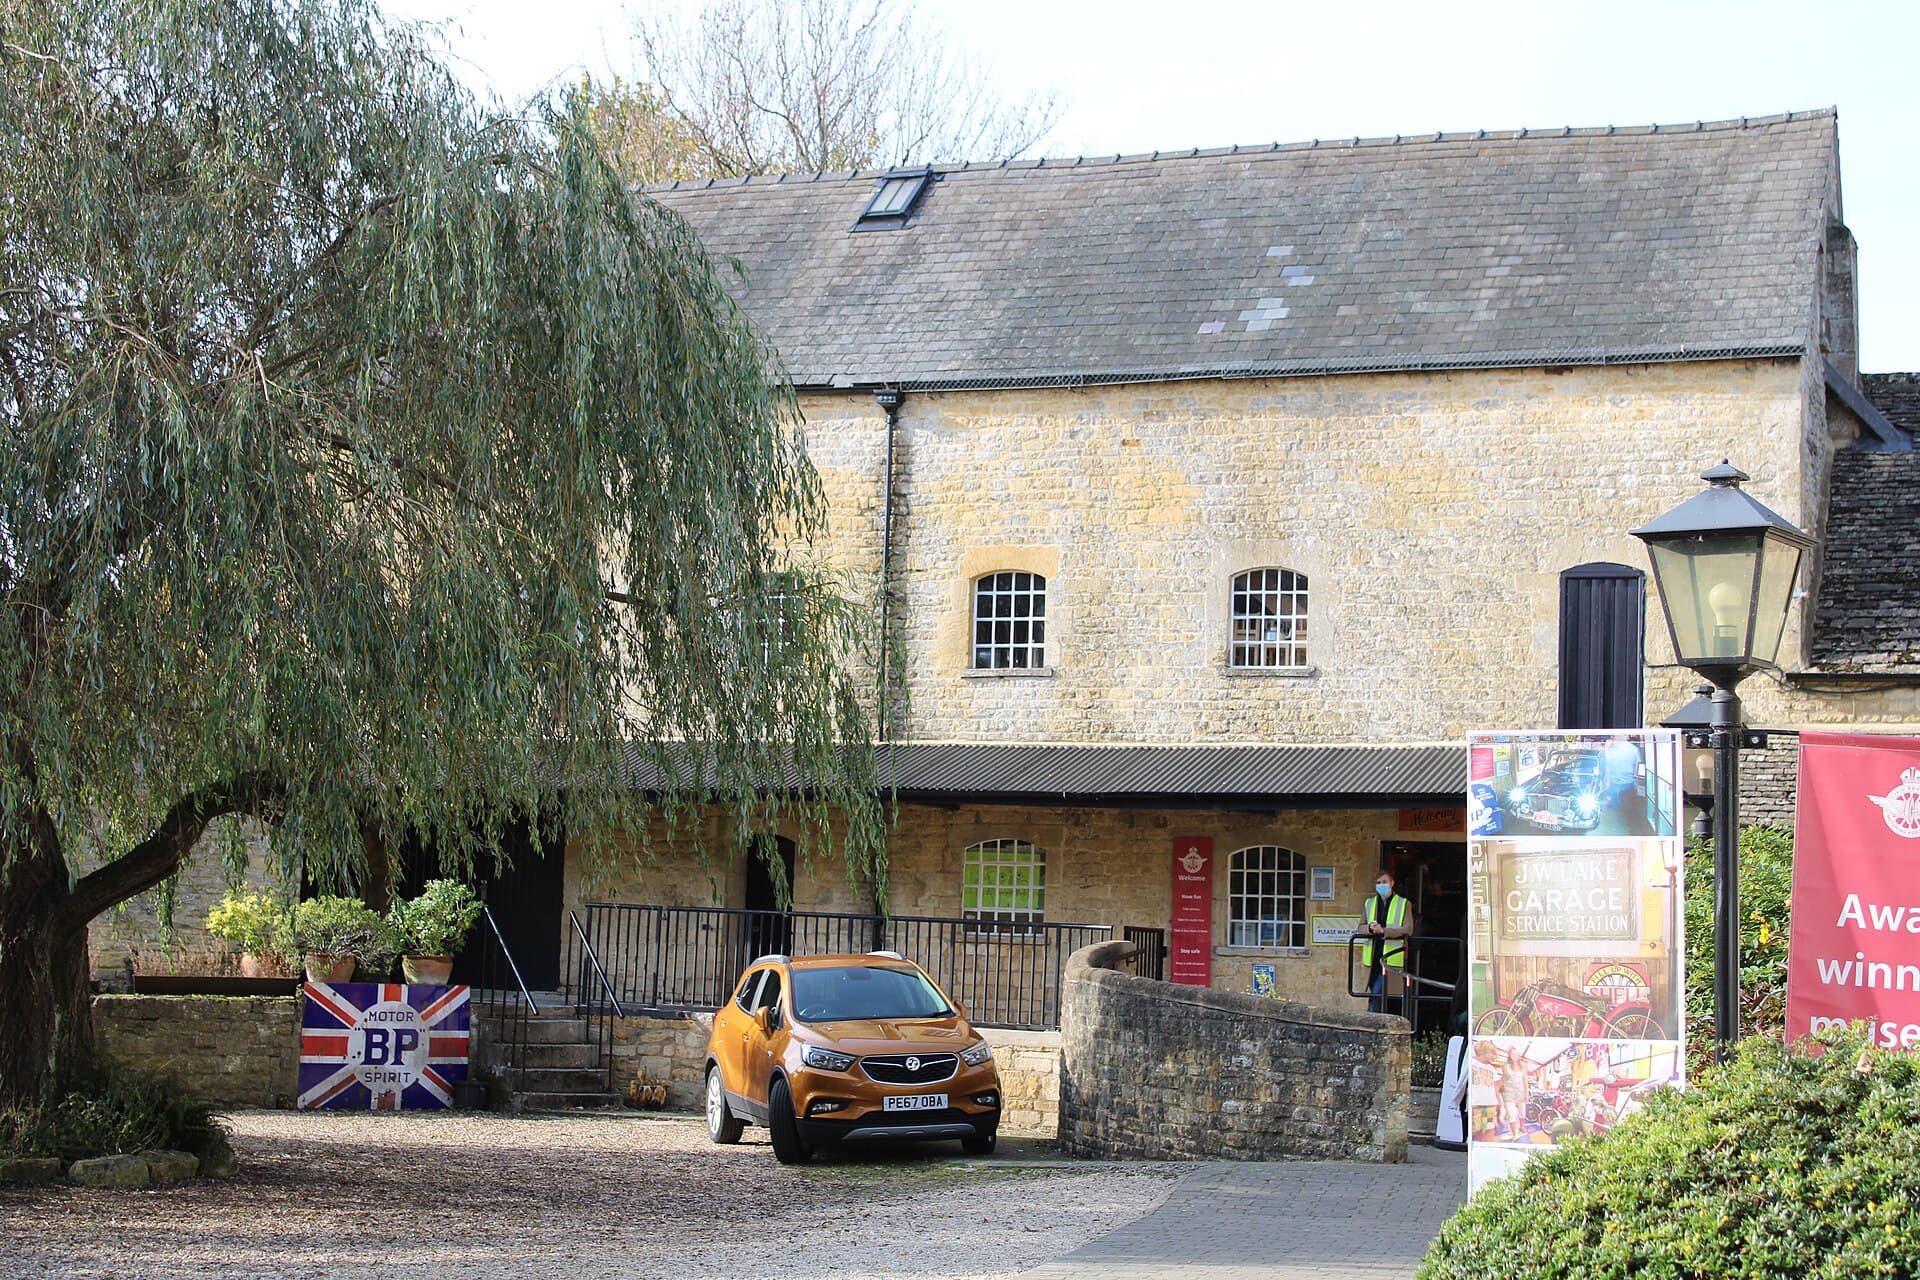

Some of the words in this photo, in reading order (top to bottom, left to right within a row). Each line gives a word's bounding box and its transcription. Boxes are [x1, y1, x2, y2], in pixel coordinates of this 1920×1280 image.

[1178, 873, 1206, 881] Welcome
[1560, 860, 1618, 881] LAKE
[1506, 887, 1623, 912] GARAGE
[1836, 893, 1920, 934] Awa
[1506, 915, 1563, 933] SERVICE
[1569, 914, 1628, 932] STATION
[1816, 951, 1920, 992] winn
[1589, 987, 1648, 1004] SHELL
[368, 1011, 414, 1022] MOTOR
[364, 1072, 412, 1084] SPIRIT
[888, 1096, 919, 1109] PE67
[921, 1095, 943, 1108] OBA
